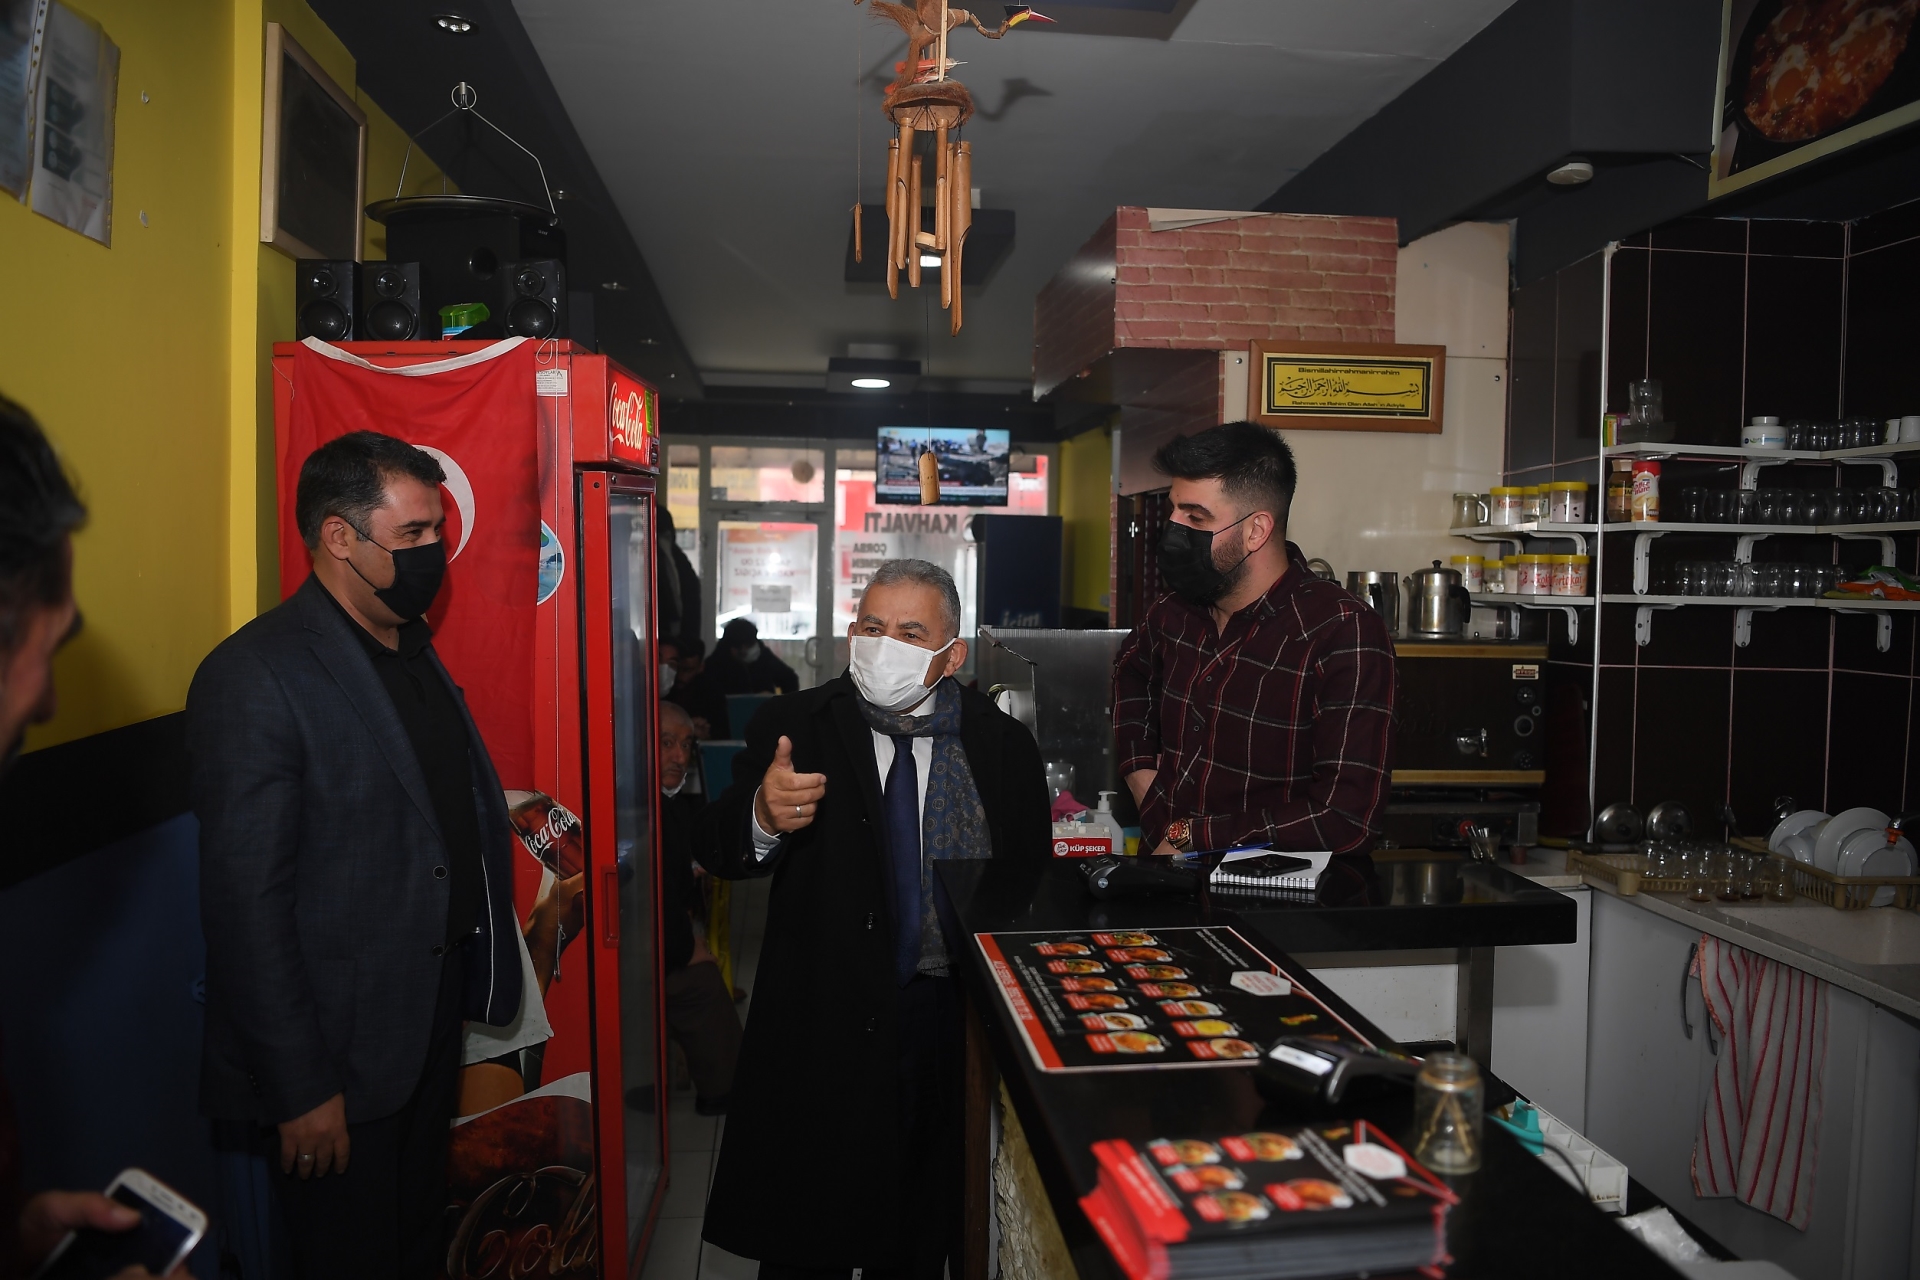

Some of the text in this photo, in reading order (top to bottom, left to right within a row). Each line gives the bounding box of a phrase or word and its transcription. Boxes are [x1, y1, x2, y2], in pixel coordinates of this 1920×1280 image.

[1298, 367, 1400, 375] Bismillahirrahmanirrahim
[609, 381, 644, 451] Coca-Cola
[525, 807, 576, 854] Coca-Cola
[1069, 844, 1085, 852] KÜP
[1085, 845, 1106, 854] ŞEKER
